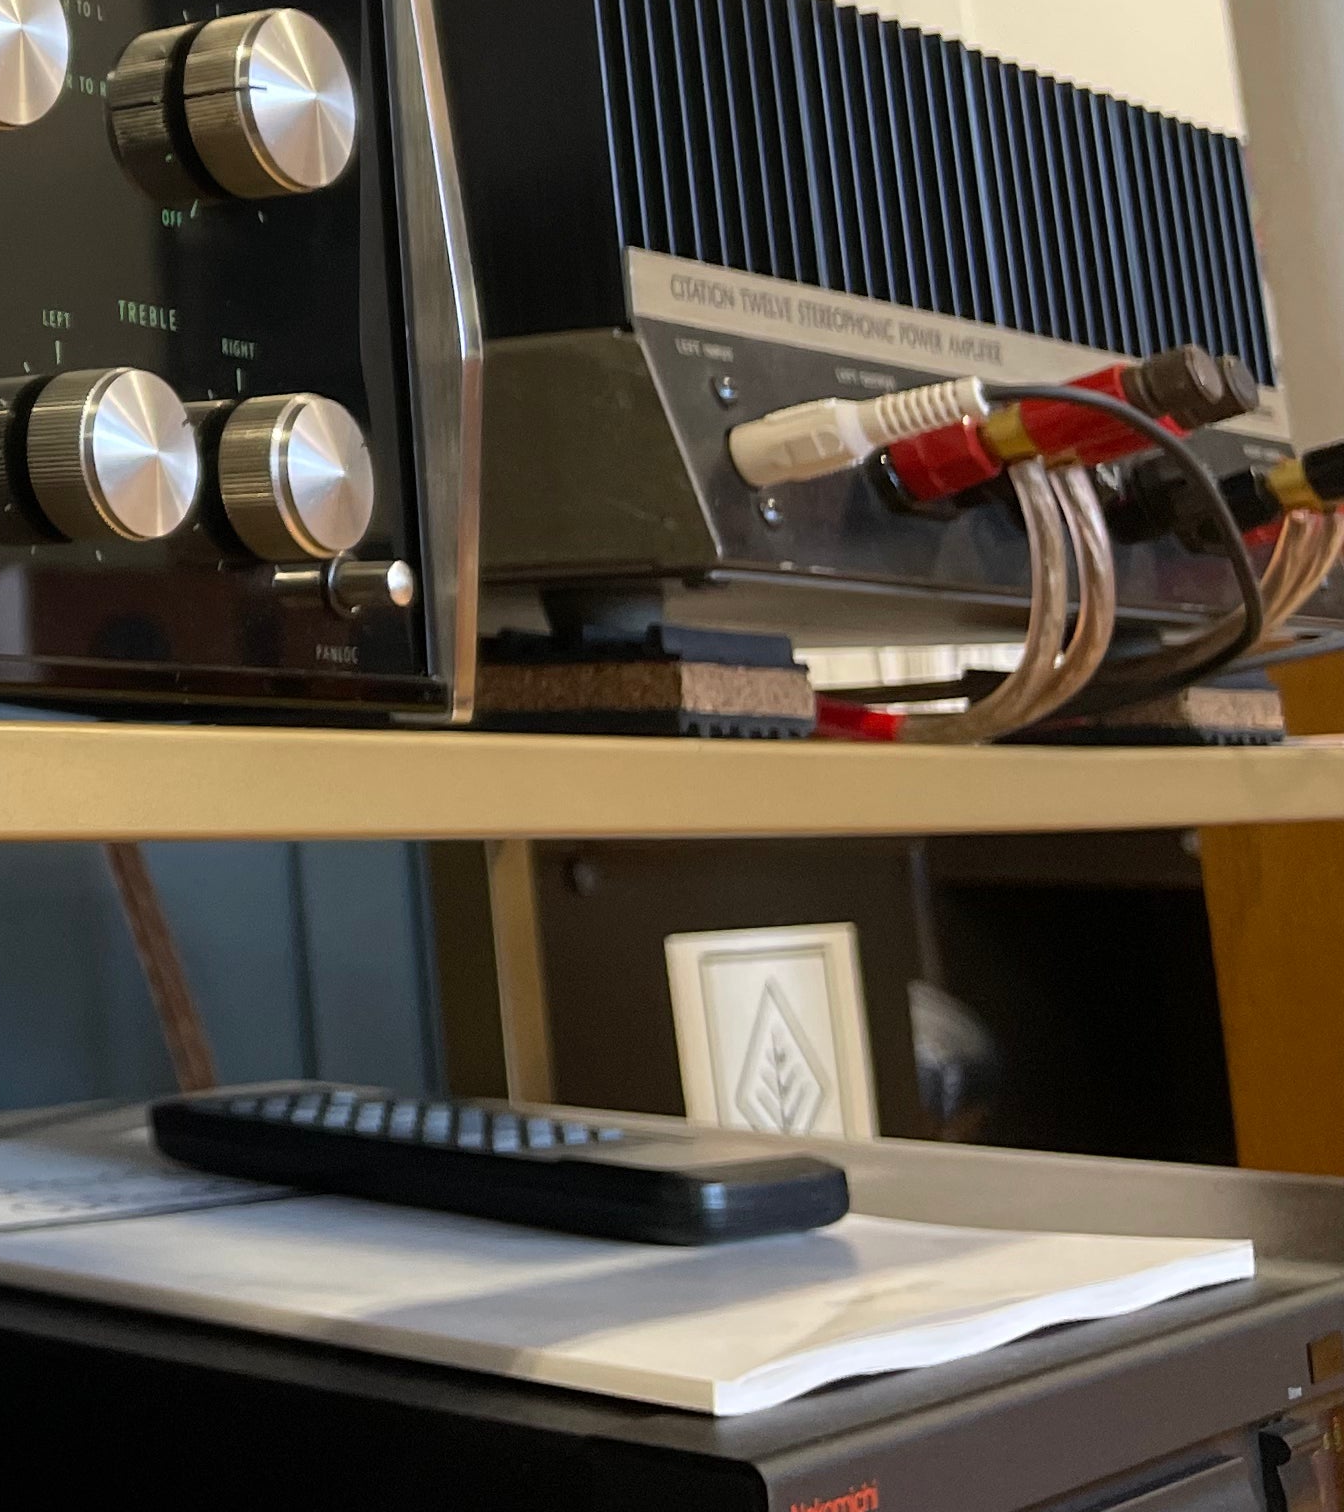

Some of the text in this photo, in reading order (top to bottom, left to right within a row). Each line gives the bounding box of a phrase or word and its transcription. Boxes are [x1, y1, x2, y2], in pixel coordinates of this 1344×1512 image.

[162, 209, 182, 227] OFF
[42, 309, 71, 329] LEFT
[118, 299, 178, 332] TREBLE
[221, 336, 256, 361] RIGHT
[315, 643, 359, 664] PANLOC
